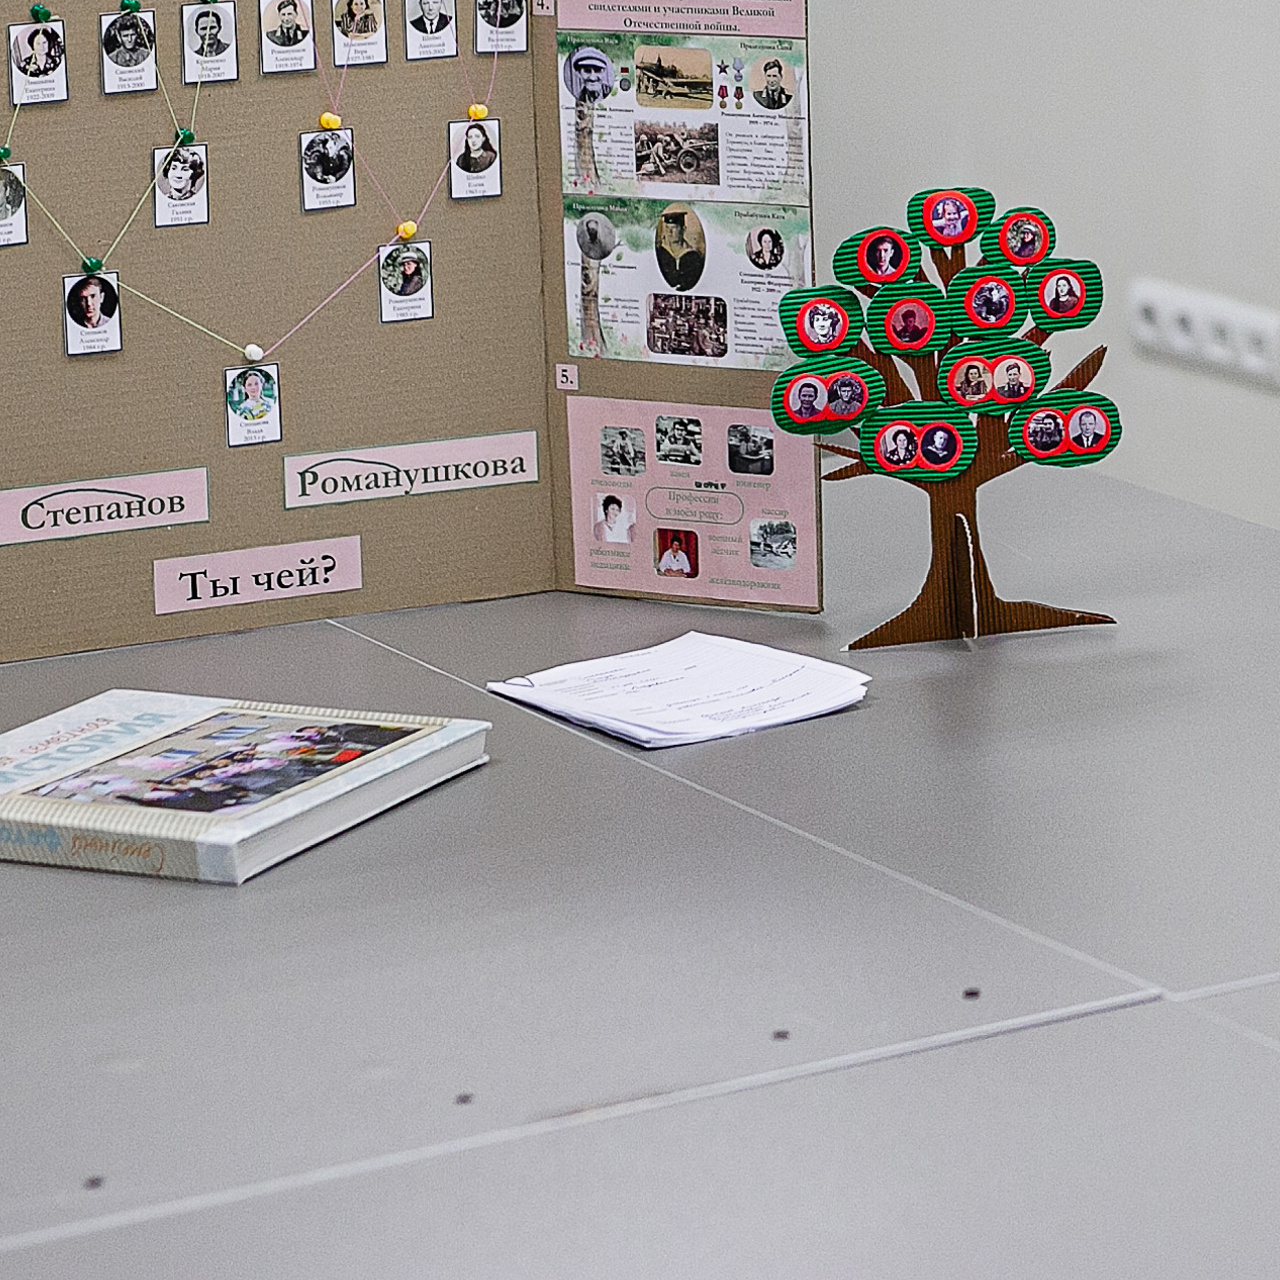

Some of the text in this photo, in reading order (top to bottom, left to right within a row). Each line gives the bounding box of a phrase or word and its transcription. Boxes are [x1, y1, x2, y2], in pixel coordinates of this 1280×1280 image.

[588, 3, 651, 12] свидетелями
[663, 6, 729, 16] участниками
[732, 6, 775, 17] Великой
[624, 18, 740, 31] Отечественной войны.
[560, 370, 574, 384] 5.
[297, 456, 526, 497] Романушкова
[21, 493, 186, 531] Степанов
[179, 555, 337, 601] Ты чей?
